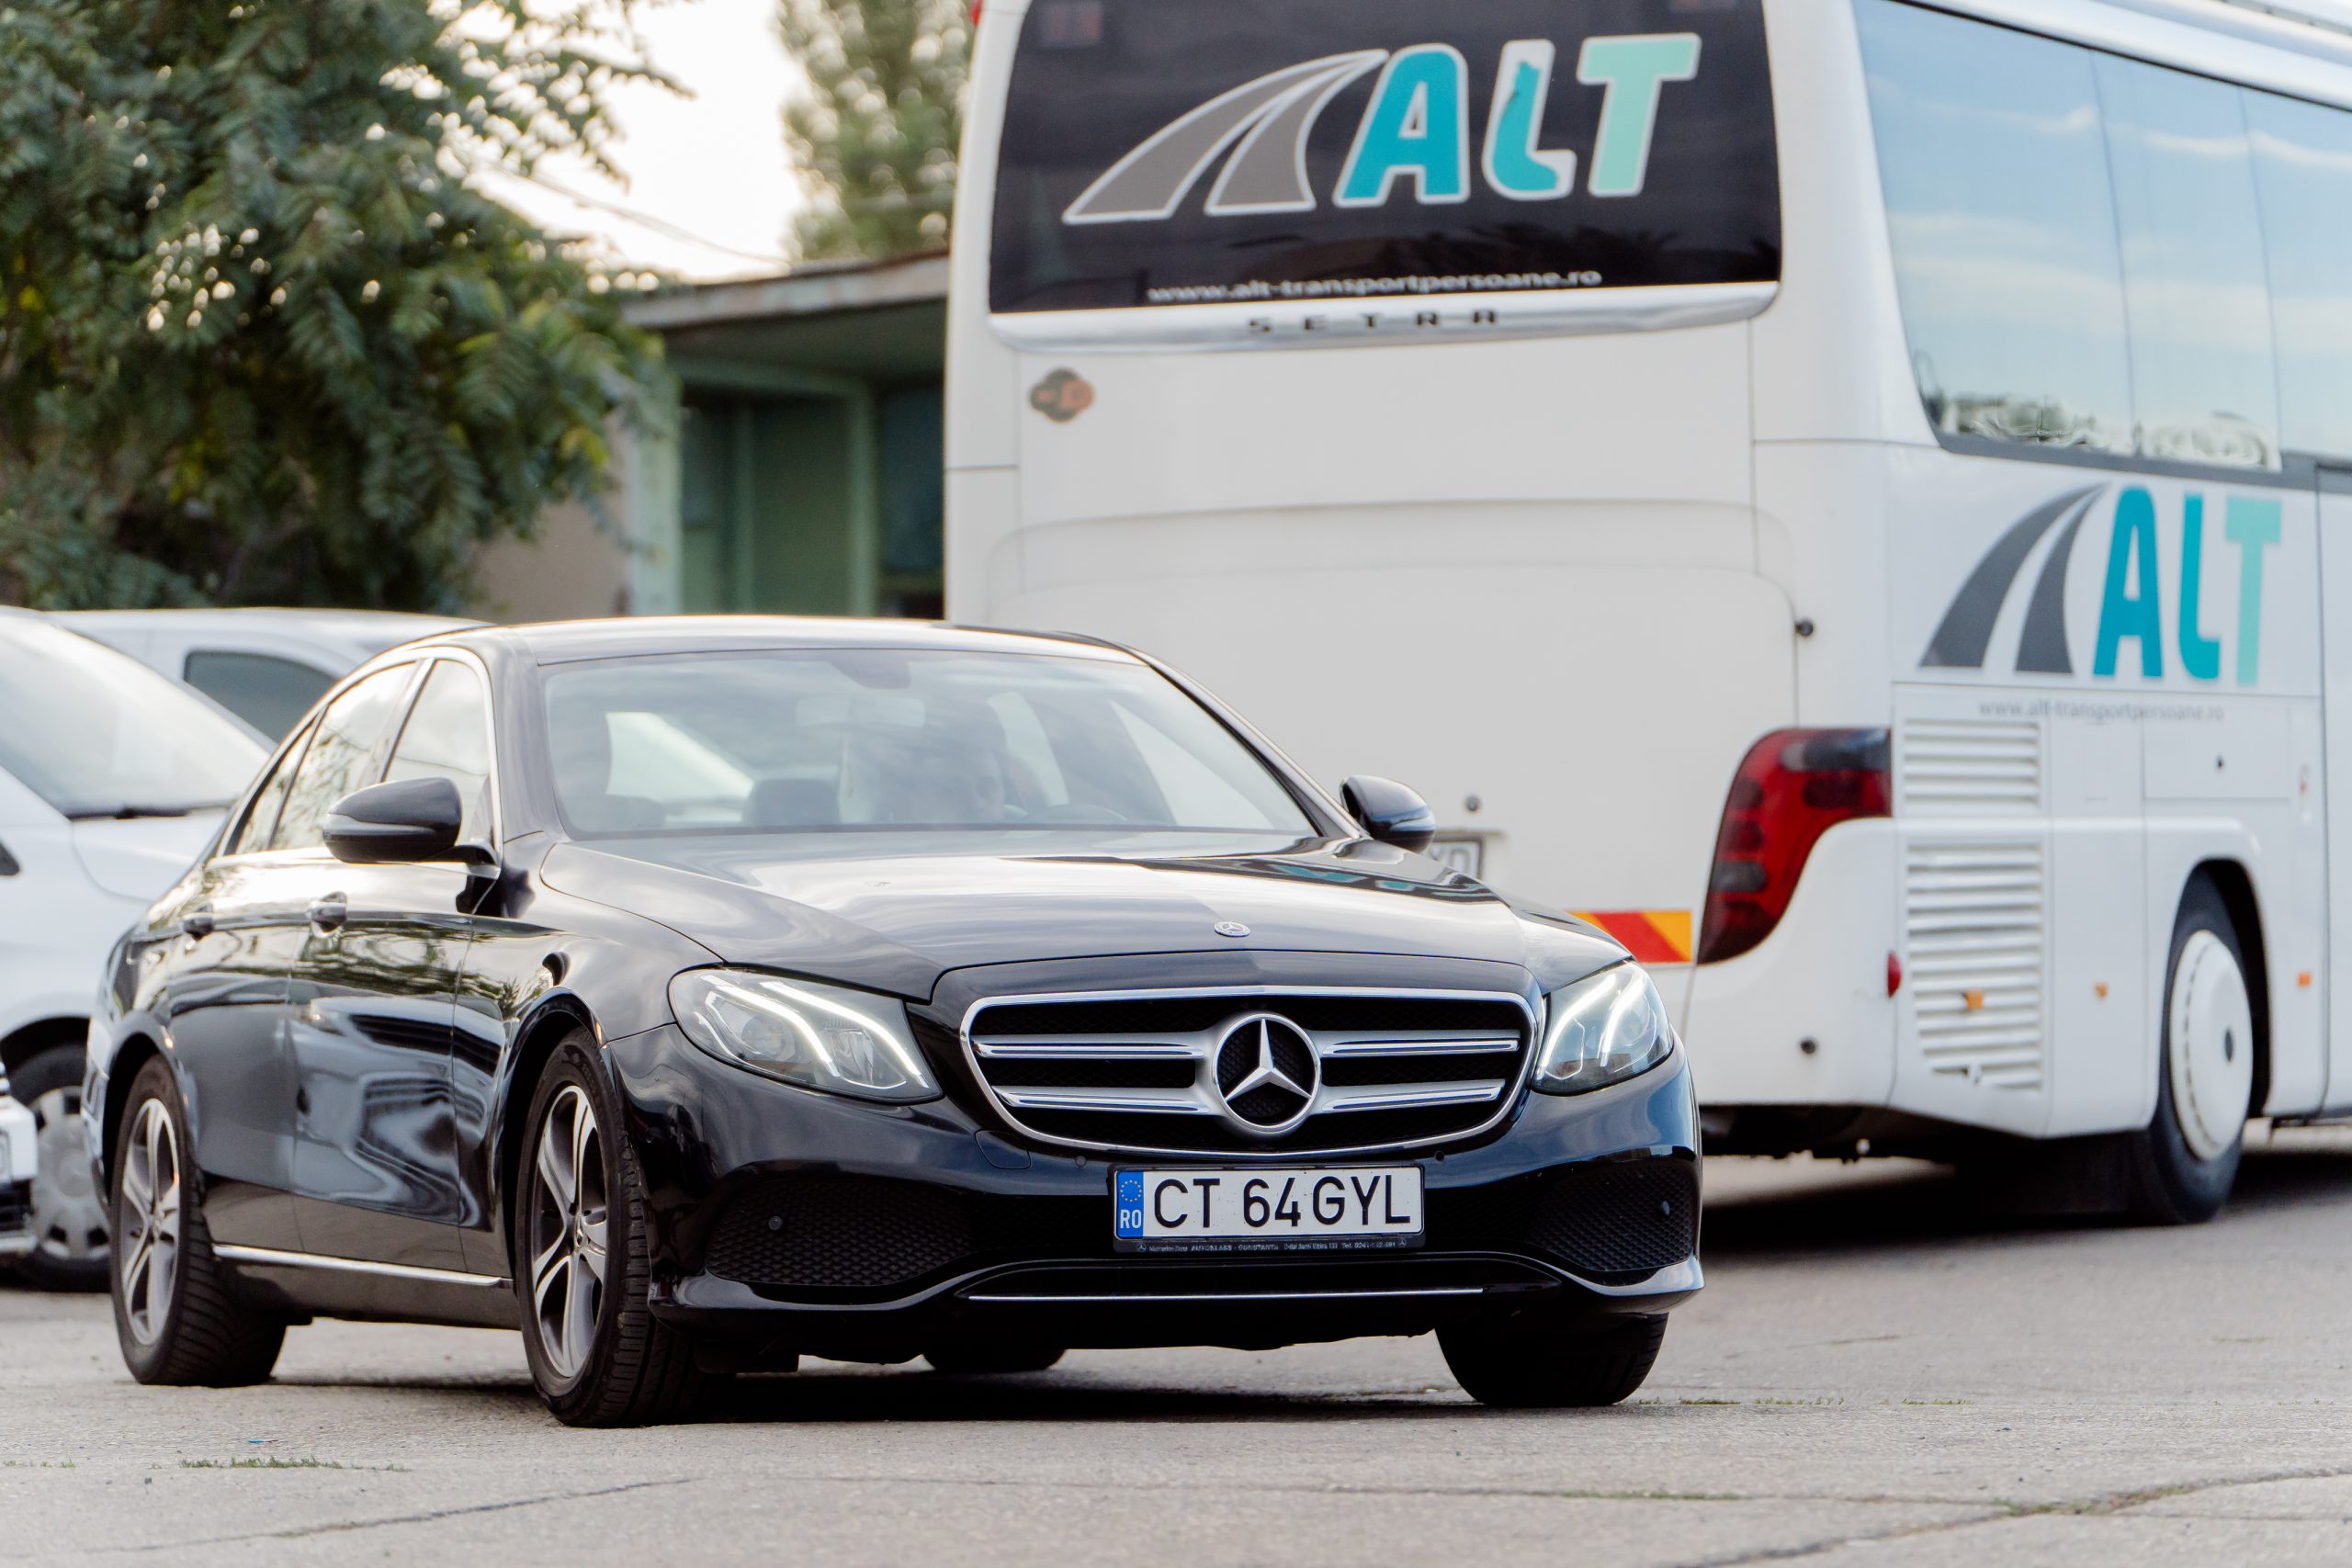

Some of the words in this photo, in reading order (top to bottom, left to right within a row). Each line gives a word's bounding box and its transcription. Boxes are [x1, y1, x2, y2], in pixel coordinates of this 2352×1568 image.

[1334, 33, 1702, 207] ALT
[1147, 268, 1603, 302] www.alt-transportpersoane.ro
[1249, 309, 1499, 334] SETRA
[2092, 485, 2283, 687] ALT
[1119, 1208, 1143, 1230] RO
[1153, 1177, 1221, 1229] CT
